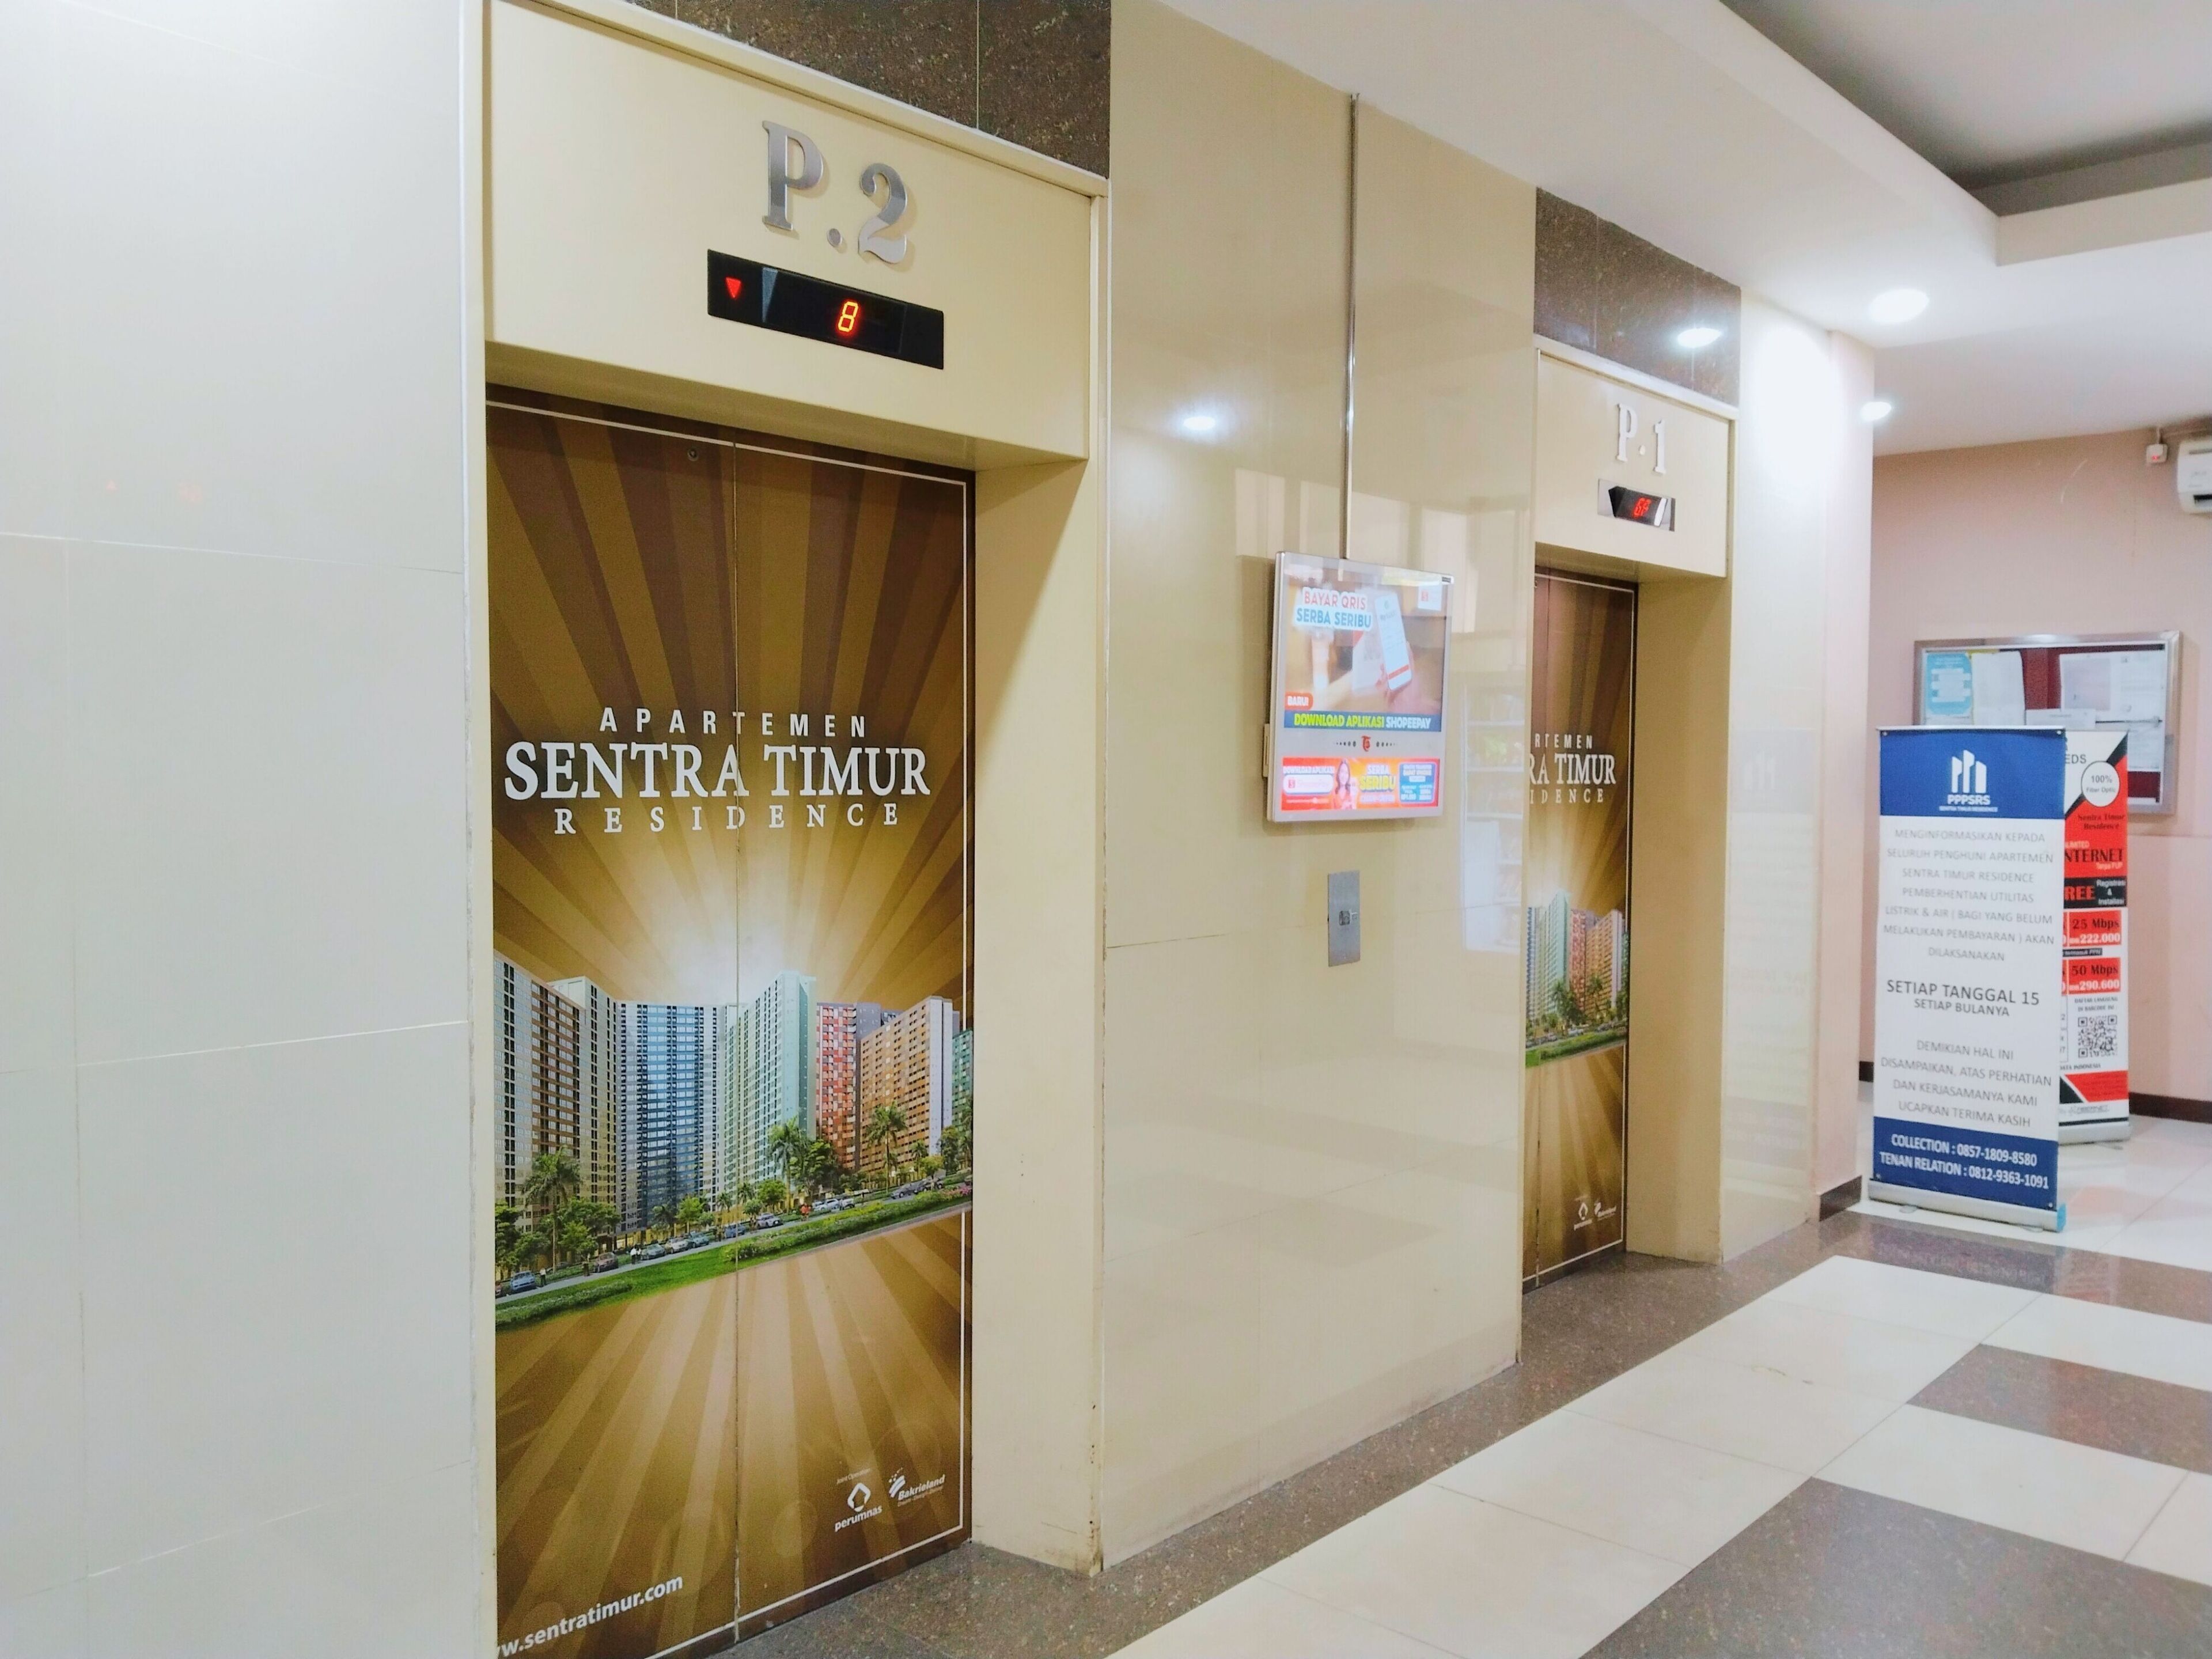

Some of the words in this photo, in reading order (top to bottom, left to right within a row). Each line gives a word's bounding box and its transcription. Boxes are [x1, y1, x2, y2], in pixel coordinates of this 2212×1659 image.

[762, 120, 907, 264] P.2
[837, 301, 859, 332] 8
[1616, 403, 1666, 474] P.1
[1305, 591, 1338, 607] BAYAR
[1342, 596, 1366, 611] QRIS
[1297, 607, 1331, 625] SERBA
[1335, 612, 1372, 628] SERIBU
[600, 707, 865, 738] APARTEMEN
[1294, 713, 1345, 726] DOWNLOAD
[1346, 715, 1384, 728] APLIKASI
[1385, 718, 1431, 729] SHOPEEPAY
[1535, 733, 1593, 749] RTEMEN
[504, 741, 749, 800] SENTRA
[763, 744, 930, 797] TIMUR
[1554, 752, 1616, 785] TIMUR
[1359, 775, 1396, 791] SERIBU
[2091, 775, 2112, 783] 100%
[1947, 794, 1991, 805] PPPSRS
[554, 803, 899, 835] RESIDENCE
[1895, 829, 2002, 840] MENGINFORMASIKAN
[2005, 832, 2046, 842] KEPADA
[1887, 848, 1931, 858] SELURUH
[1933, 850, 1987, 861] PENGHUNI
[1989, 852, 2054, 863] APARTEMEN
[1903, 868, 1940, 878] SENTRA
[1943, 870, 1976, 880] TIMUR
[1979, 872, 2035, 882] RESIDENCE
[1903, 888, 1987, 900] PEMBERHENTIAN
[1990, 892, 2034, 903] UTILITAS
[1885, 906, 1919, 916] LISTRIK
[1922, 907, 1929, 916] &
[1933, 908, 1948, 918] AIR
[1958, 910, 1982, 920] BAGI
[1985, 912, 2013, 922] YANG
[2016, 912, 2052, 924] BELUM
[2073, 919, 2088, 929] 25
[2092, 918, 2120, 930] Mbps
[1884, 925, 1944, 937] MELAKUKAN
[1946, 929, 2015, 942] PEMBAYARAN
[2025, 934, 2055, 945] AKAN
[1928, 947, 2005, 961] DILAKSANAKAN
[2072, 965, 2086, 975] 50
[2091, 964, 2119, 977] Mbps
[1887, 979, 1937, 995] SETIAP
[1942, 984, 2016, 1003] TANGGAL
[2022, 991, 2039, 1005] 15
[1914, 998, 1952, 1010] SETIAP
[1955, 1002, 2009, 1016] BULANYA
[1916, 1040, 1970, 1056] DEMIKIAN
[1974, 1047, 1995, 1059] HAL
[1999, 1049, 2013, 1060] INI
[1960, 1067, 1986, 1080] ATAS
[1989, 1069, 2052, 1086] PERHATIAN
[1893, 1079, 1916, 1092] DAN
[1919, 1082, 2004, 1103] KERJASAMANYA
[2008, 1093, 2037, 1107] KAMI
[1899, 1101, 1949, 1117] UCAPKAN
[1952, 1107, 1995, 1123] TERIMA
[1998, 1113, 2031, 1127] KASIH
[1891, 1133, 1950, 1154] COLLECTION
[1957, 1143, 2037, 1167] 0857-1809-8580
[1879, 1152, 1914, 1169] TENAN
[1914, 1157, 1962, 1176] RELATION
[1968, 1165, 2049, 1190] 0812-9363-1091
[835, 1505, 882, 1533] perumnas
